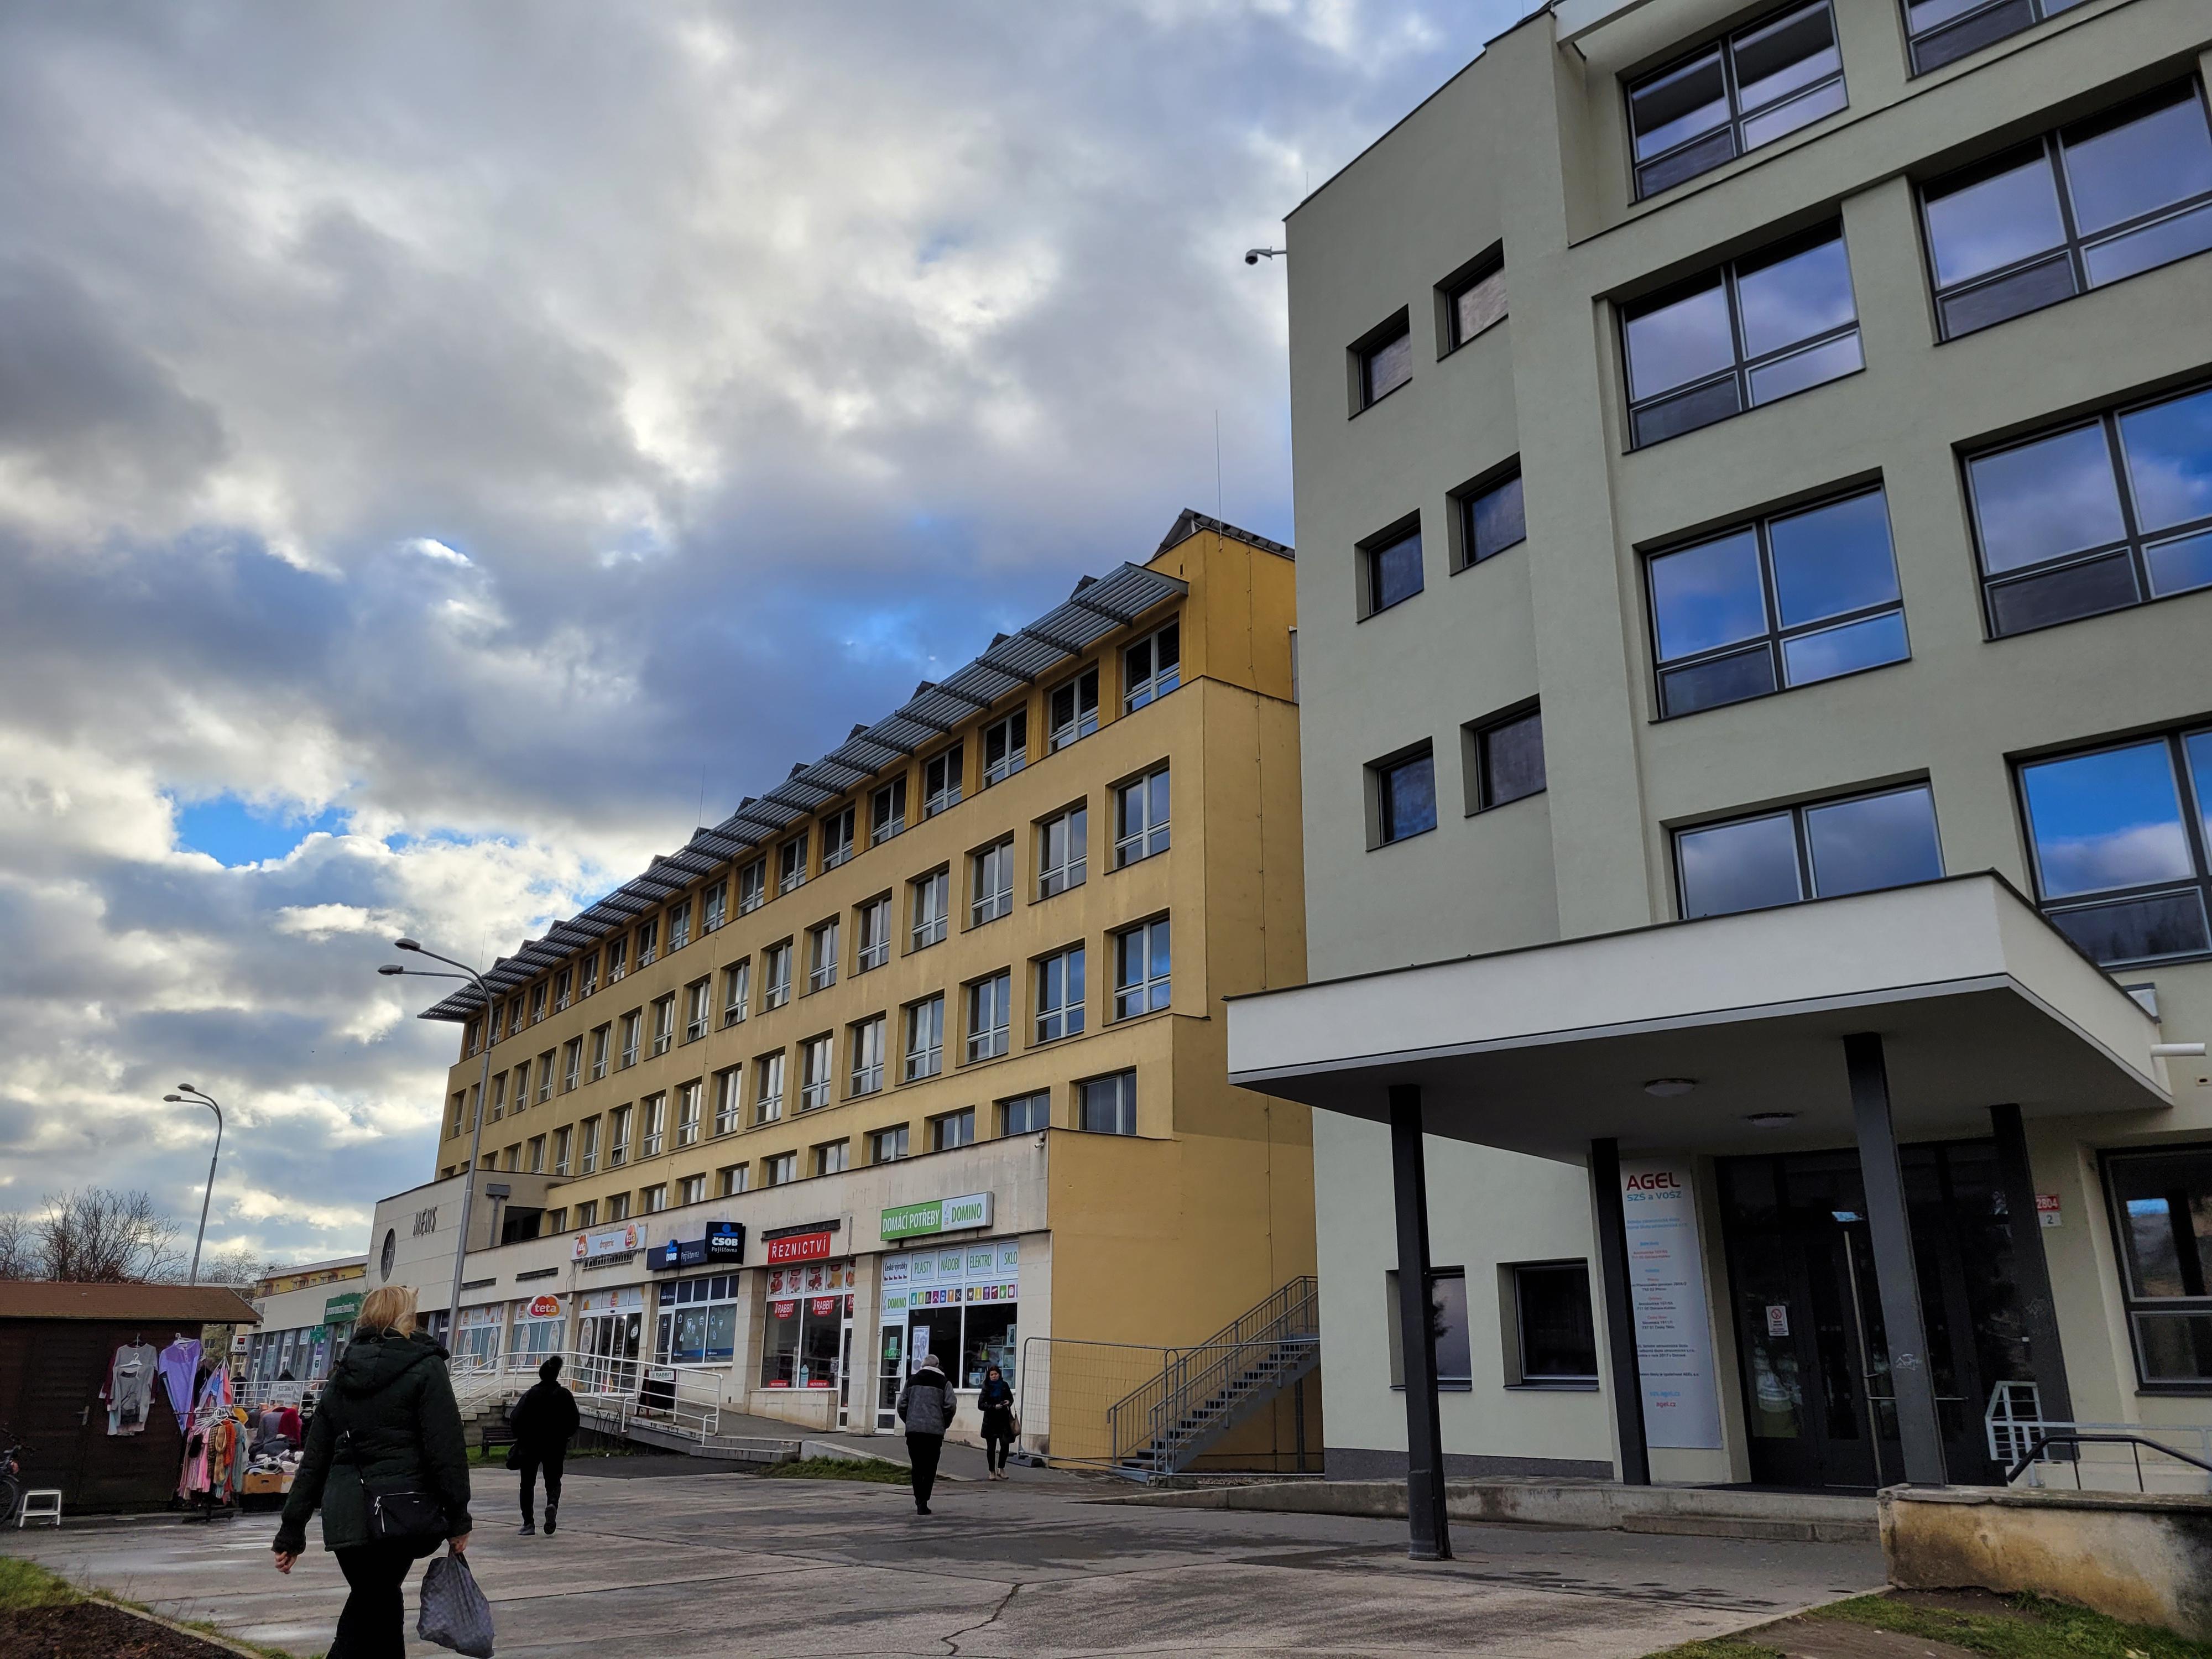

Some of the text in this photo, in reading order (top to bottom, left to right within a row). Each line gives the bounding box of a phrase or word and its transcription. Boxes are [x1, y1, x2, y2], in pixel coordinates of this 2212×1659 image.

[1626, 1172, 1681, 1191] AGEL
[1627, 1192, 1646, 1201] SZŠ
[2036, 1198, 2058, 1208] 2804
[951, 1202, 982, 1223] DOMINO
[883, 1208, 940, 1233] DOMÁCÍ POTŘEBY
[2047, 1214, 2053, 1224] 2
[712, 1237, 738, 1246] ČSOB
[771, 1235, 827, 1259] ŘEZNICTVÍ
[941, 1255, 961, 1271] NÁDOBÍ
[969, 1254, 992, 1268] ELEKTRO
[1004, 1251, 1018, 1265] SKLO
[894, 1261, 907, 1272] výrobky
[914, 1261, 932, 1274] PLASTY
[535, 1303, 556, 1313] teta
[778, 1303, 794, 1313] RABBIT
[817, 1300, 834, 1311] RABBIT
[888, 1297, 906, 1309] DOMINO
